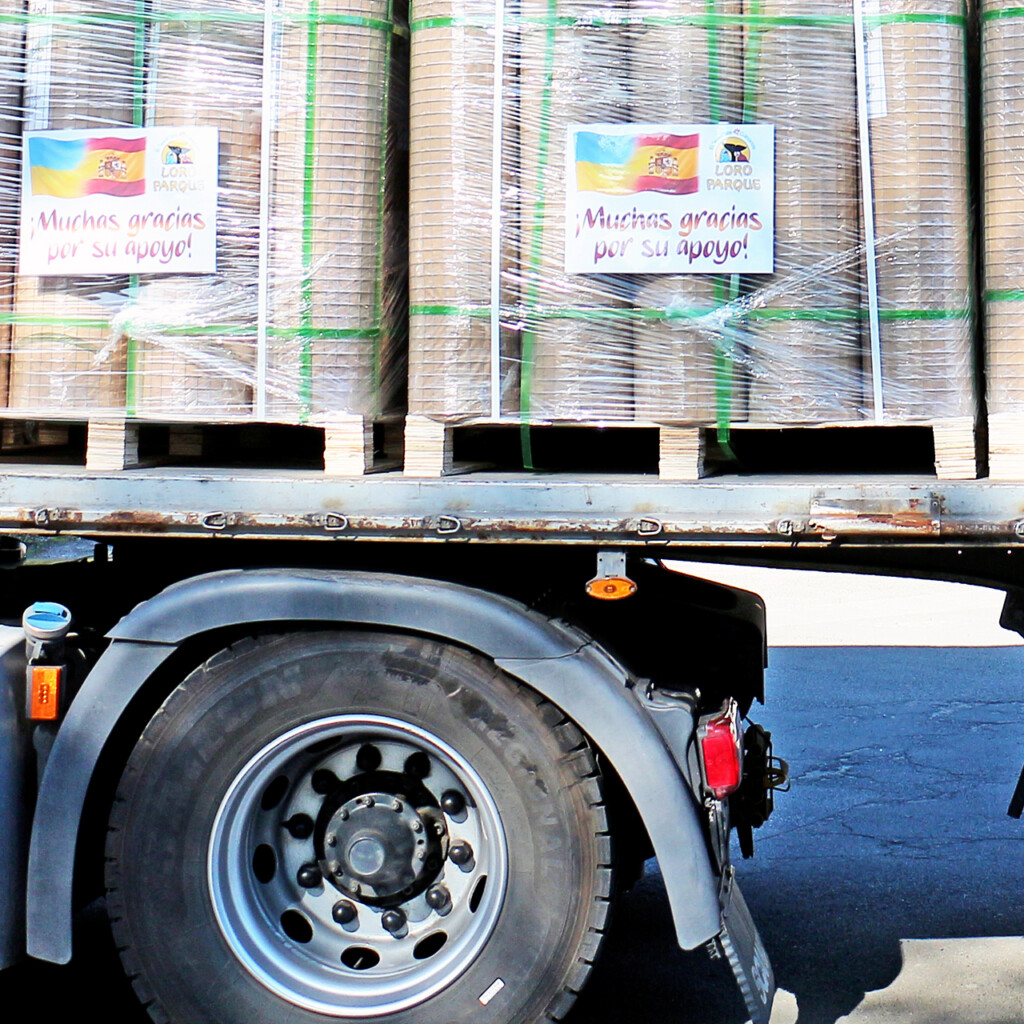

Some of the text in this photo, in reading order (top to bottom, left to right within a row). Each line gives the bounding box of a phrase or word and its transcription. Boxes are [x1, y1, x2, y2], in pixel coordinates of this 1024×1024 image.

[161, 166, 197, 178] LORO
[715, 164, 753, 176] LORO
[153, 180, 205, 193] PARQUE
[706, 178, 761, 192] PARQUE
[30, 205, 206, 241] ¡Muchas gracias
[575, 204, 762, 238] ¡Muchas gracias
[47, 233, 193, 265] por su apoyo!
[594, 232, 748, 264] por su apoyo!
